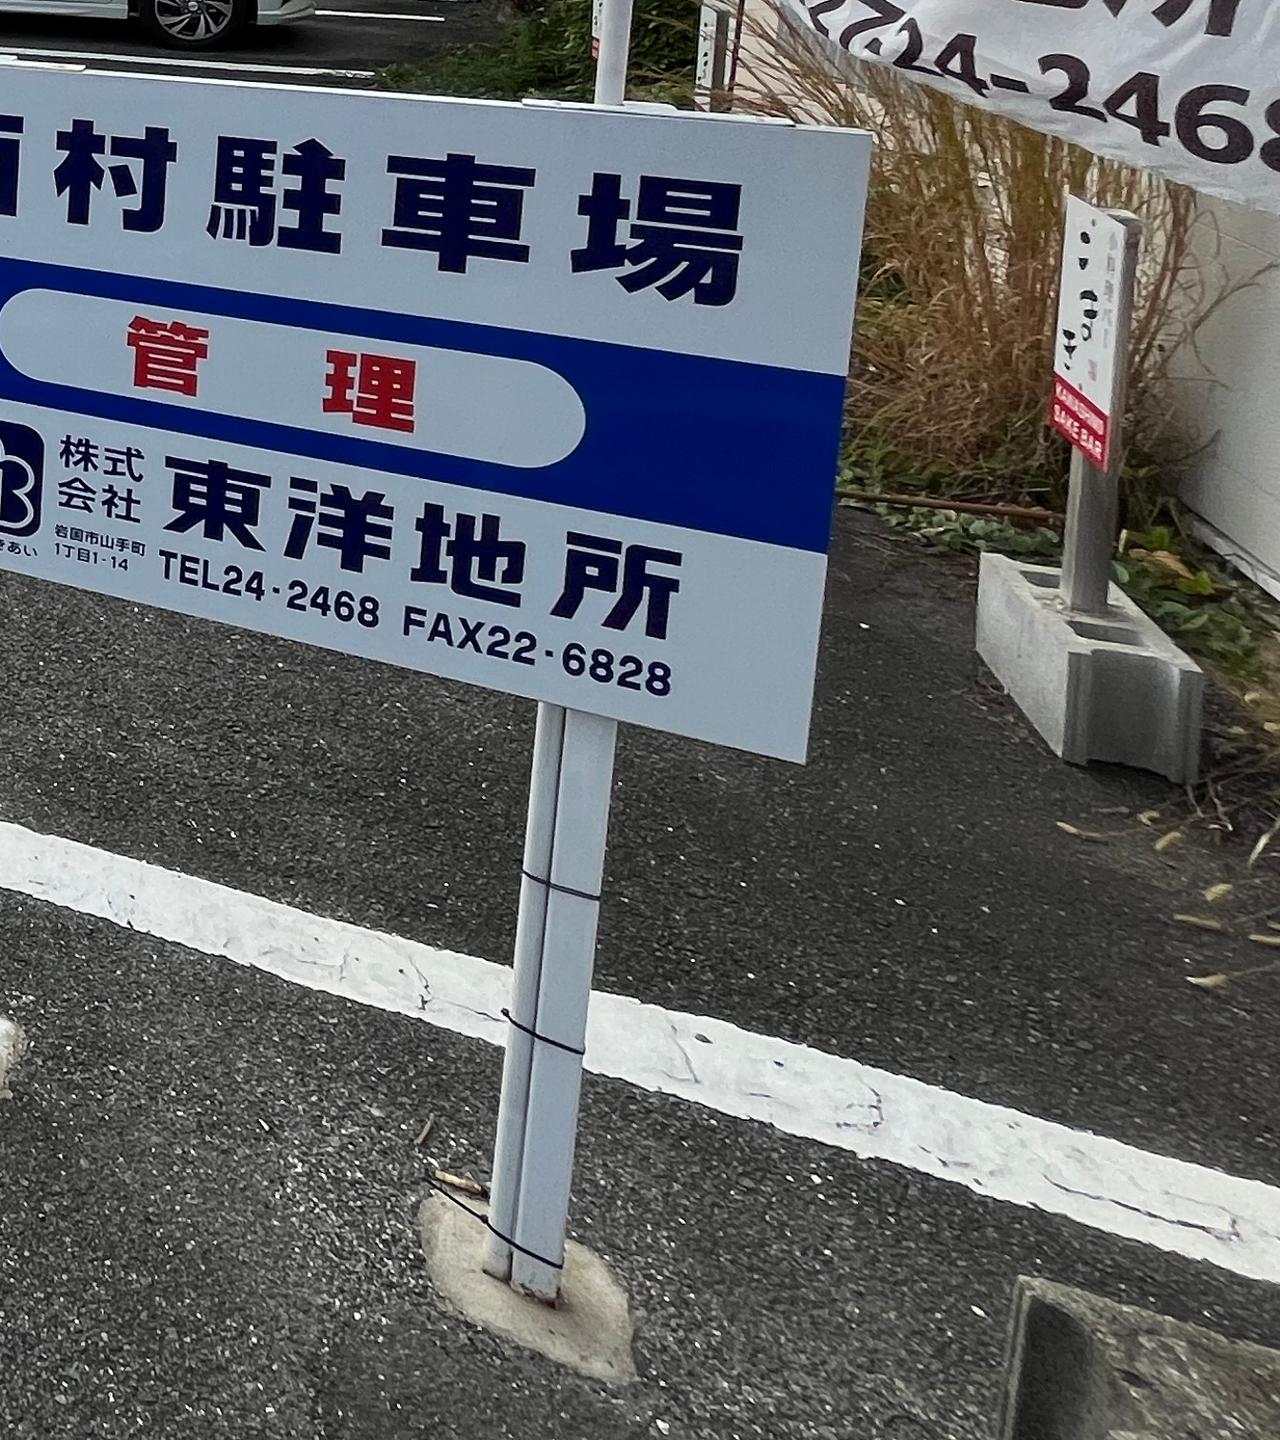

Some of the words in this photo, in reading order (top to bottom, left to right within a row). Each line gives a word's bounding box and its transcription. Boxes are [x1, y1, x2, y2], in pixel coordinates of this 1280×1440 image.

[127, 316, 415, 433] 管理
[54, 523, 146, 557] 岩国市山手町
[54, 542, 129, 572] 1丁目1-14
[163, 456, 683, 640] 東洋地所
